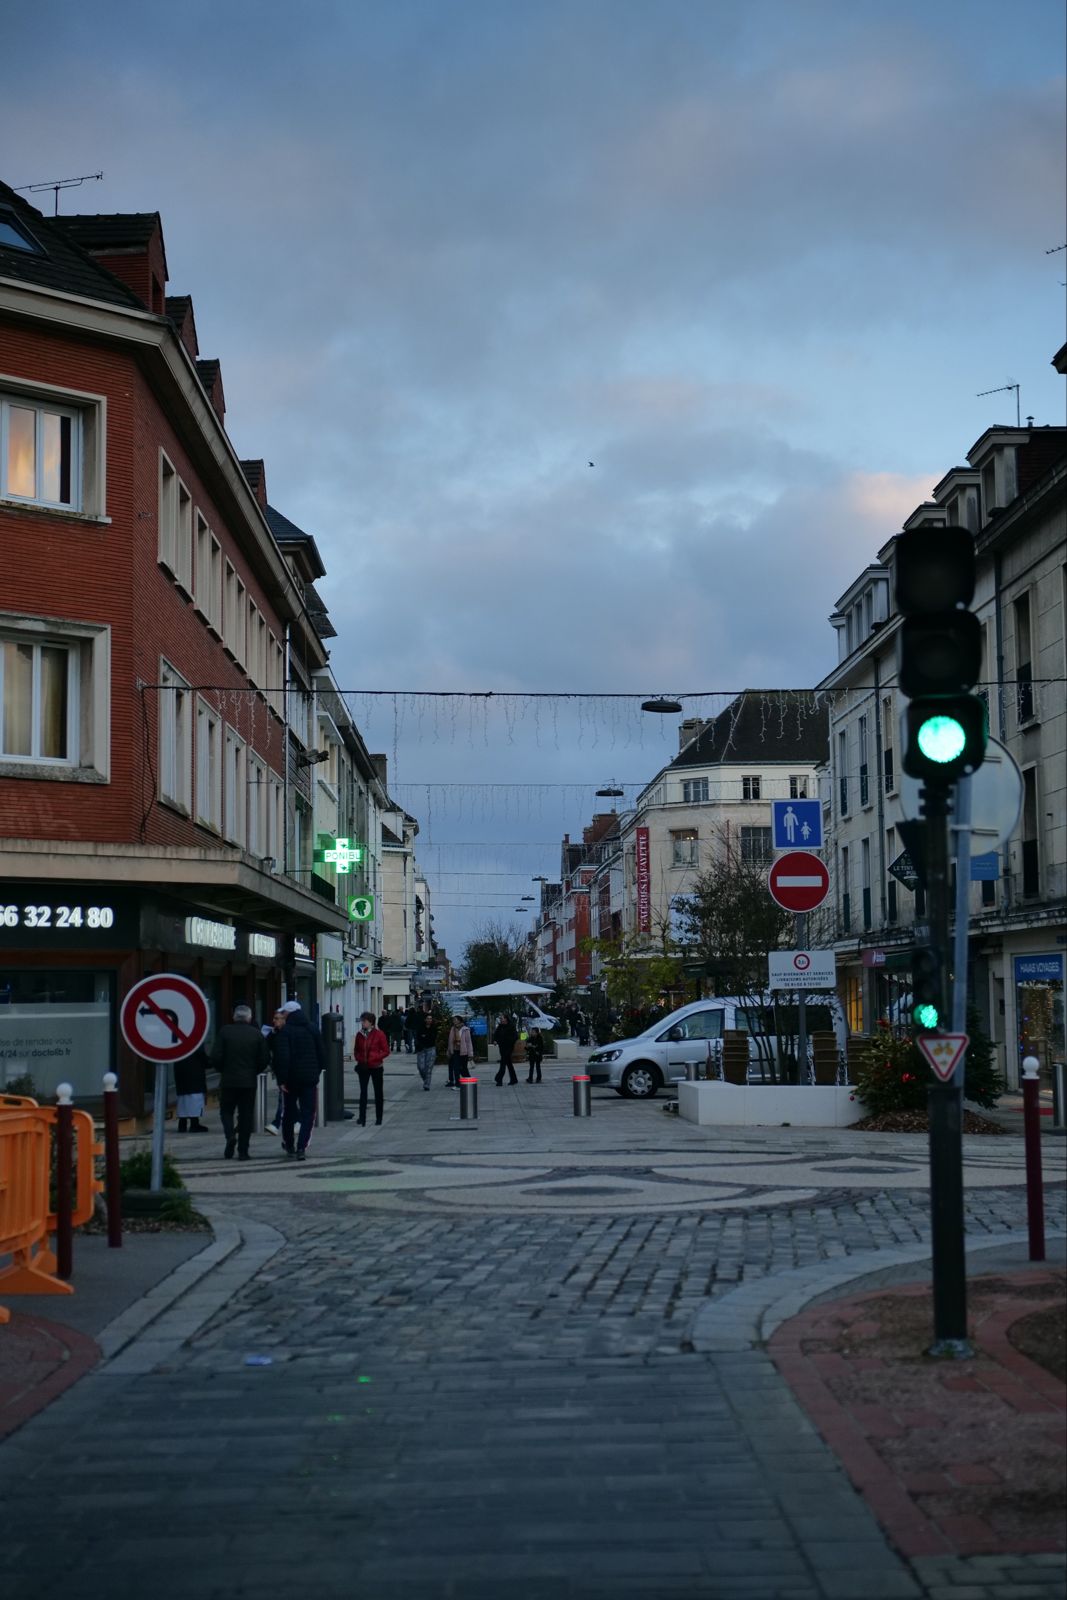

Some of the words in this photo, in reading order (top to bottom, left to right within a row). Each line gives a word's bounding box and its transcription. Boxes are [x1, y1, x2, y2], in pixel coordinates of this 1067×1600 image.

[639, 835, 648, 882] LAFAYETTE
[24, 905, 51, 927] 32
[56, 906, 83, 928] 24
[87, 907, 114, 928] 80
[640, 884, 649, 927] GALERIES
[1036, 962, 1060, 973] VOYAGES
